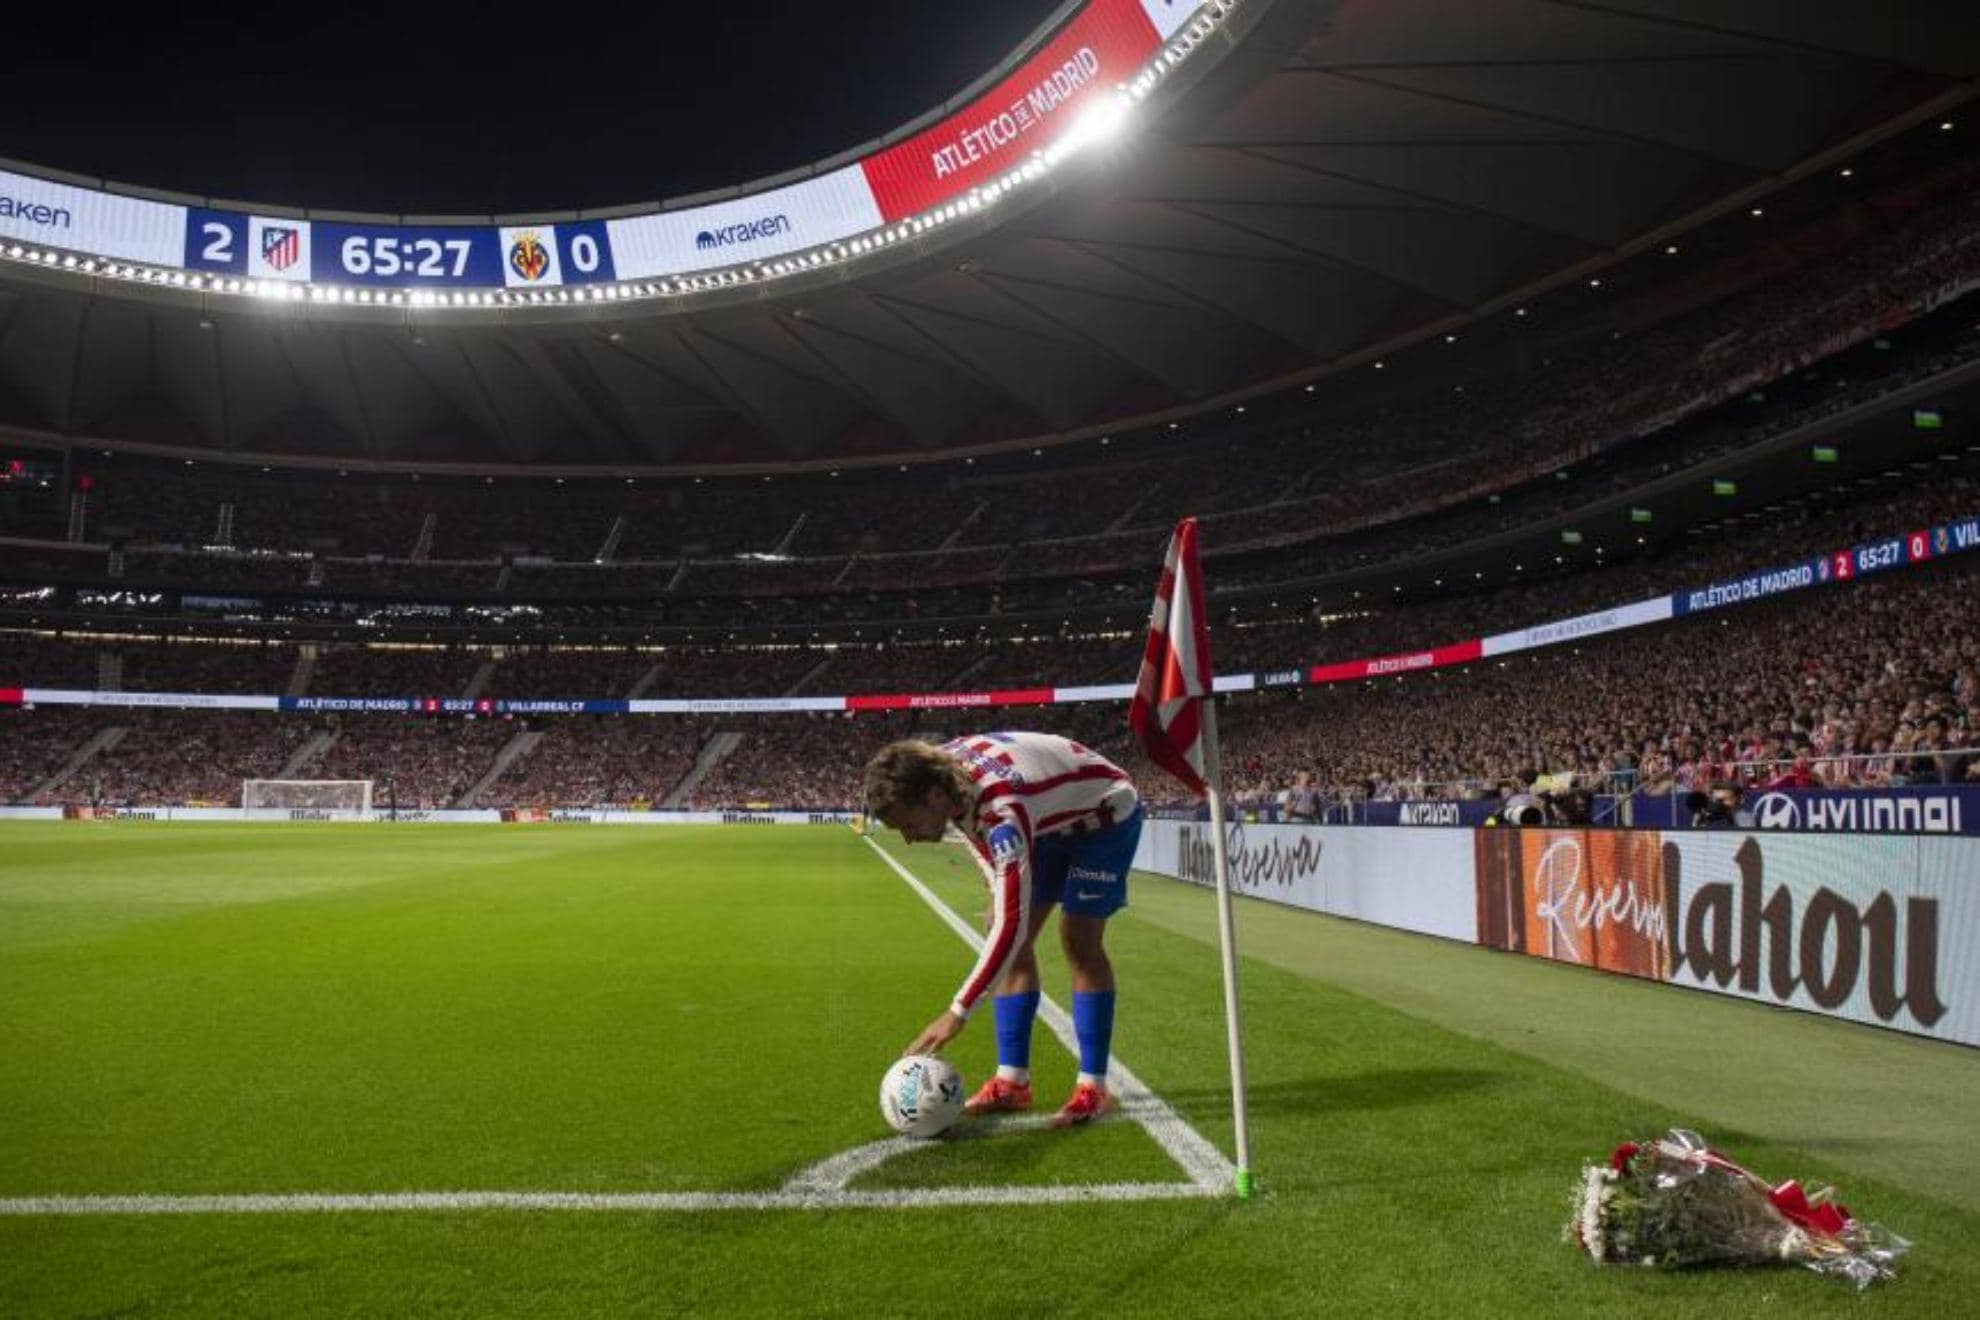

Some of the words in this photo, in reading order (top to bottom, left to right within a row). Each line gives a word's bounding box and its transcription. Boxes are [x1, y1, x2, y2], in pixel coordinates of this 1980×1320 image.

[931, 128, 1017, 180] ATLÉTICO
[1026, 47, 1099, 120] MADRID
[202, 222, 233, 262] 2
[714, 214, 791, 246] kraken
[342, 236, 471, 276] 65:27
[571, 234, 599, 272] 0
[1837, 555, 1848, 577] 2
[1859, 541, 1900, 571] 65:27
[1912, 536, 1924, 558] 0
[1690, 583, 1742, 611] ATLÉTICO
[1742, 578, 1760, 599] DE
[1761, 566, 1813, 595] MADRID
